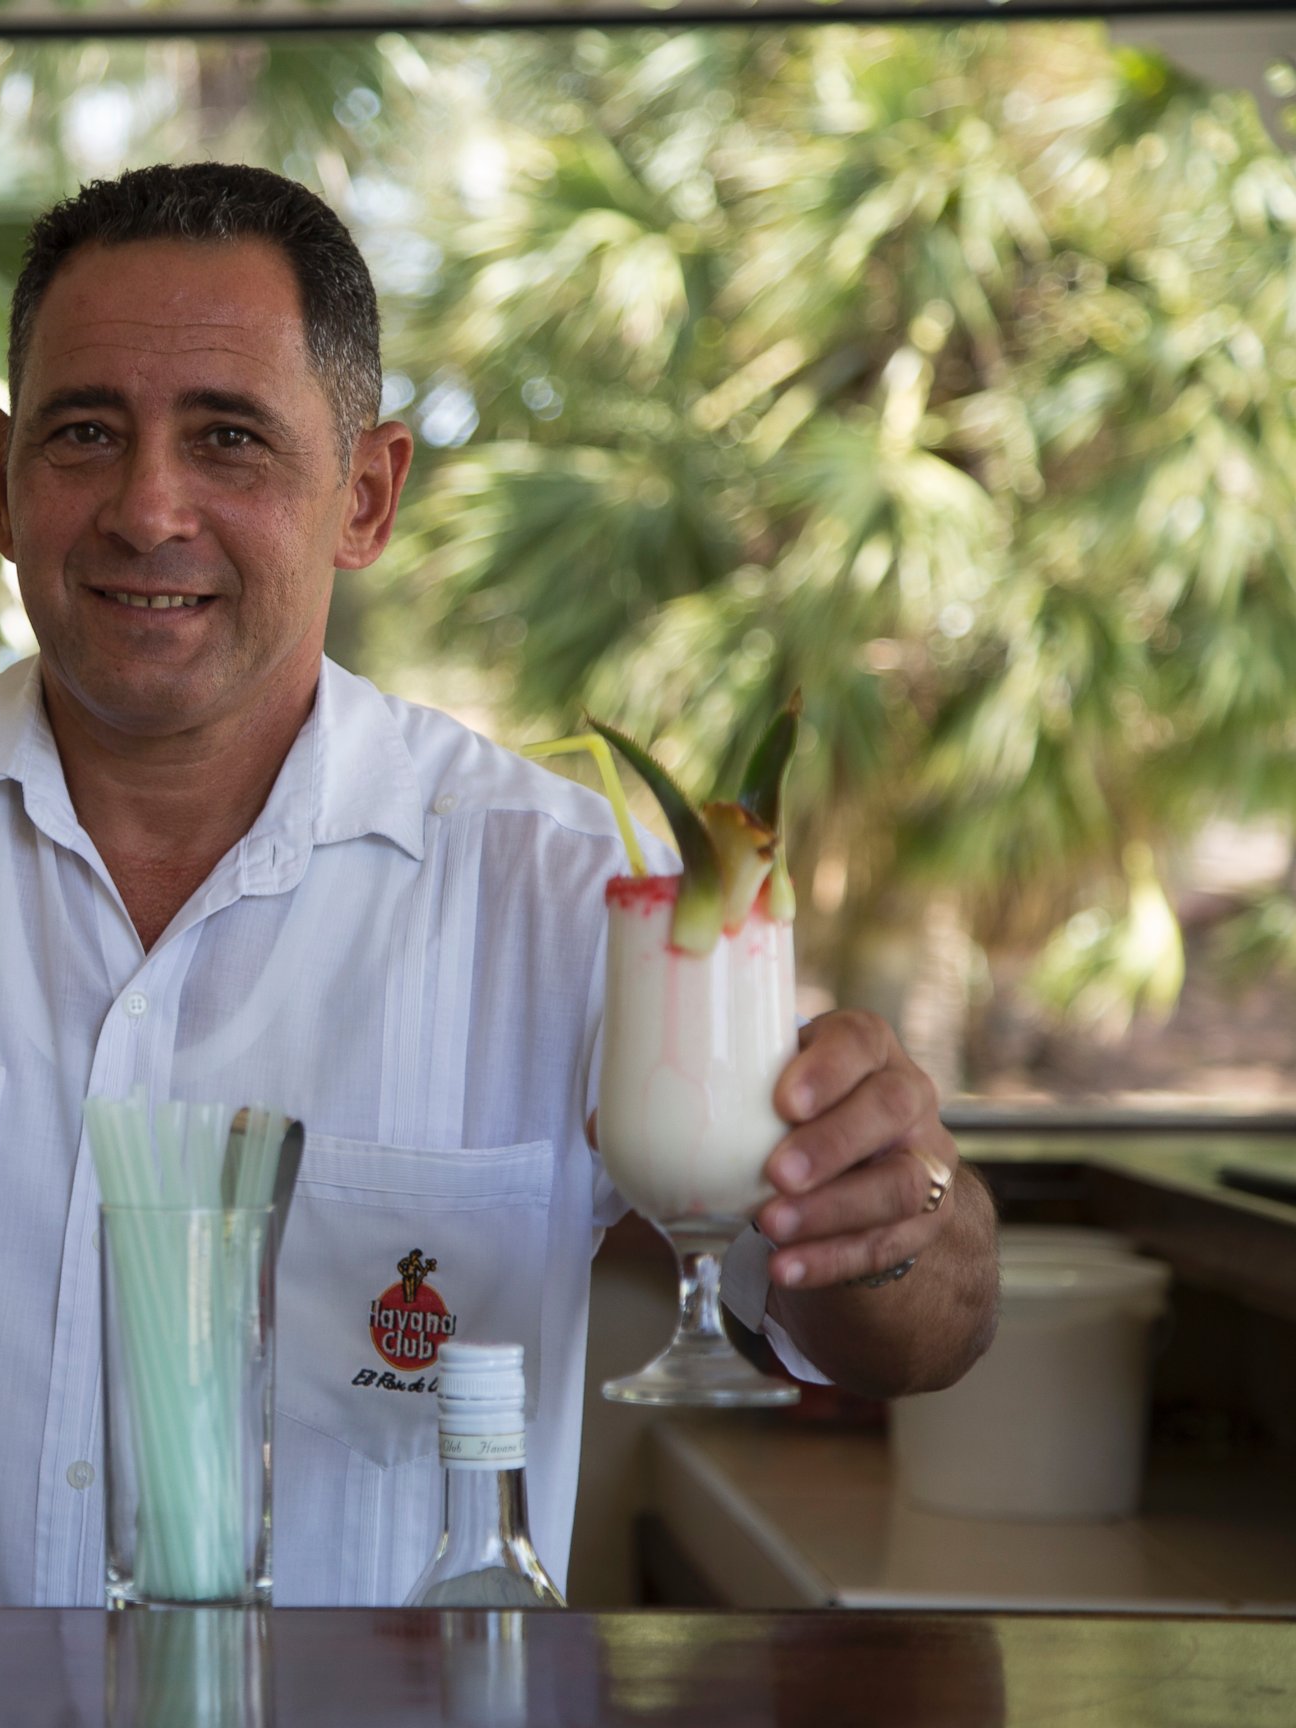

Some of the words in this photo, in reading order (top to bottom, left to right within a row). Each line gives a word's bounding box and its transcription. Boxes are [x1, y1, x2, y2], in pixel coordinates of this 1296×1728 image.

[369, 1300, 456, 1336] Havana
[382, 1331, 434, 1361] Club
[376, 1372, 406, 1392] Ron
[408, 1376, 425, 1393] de
